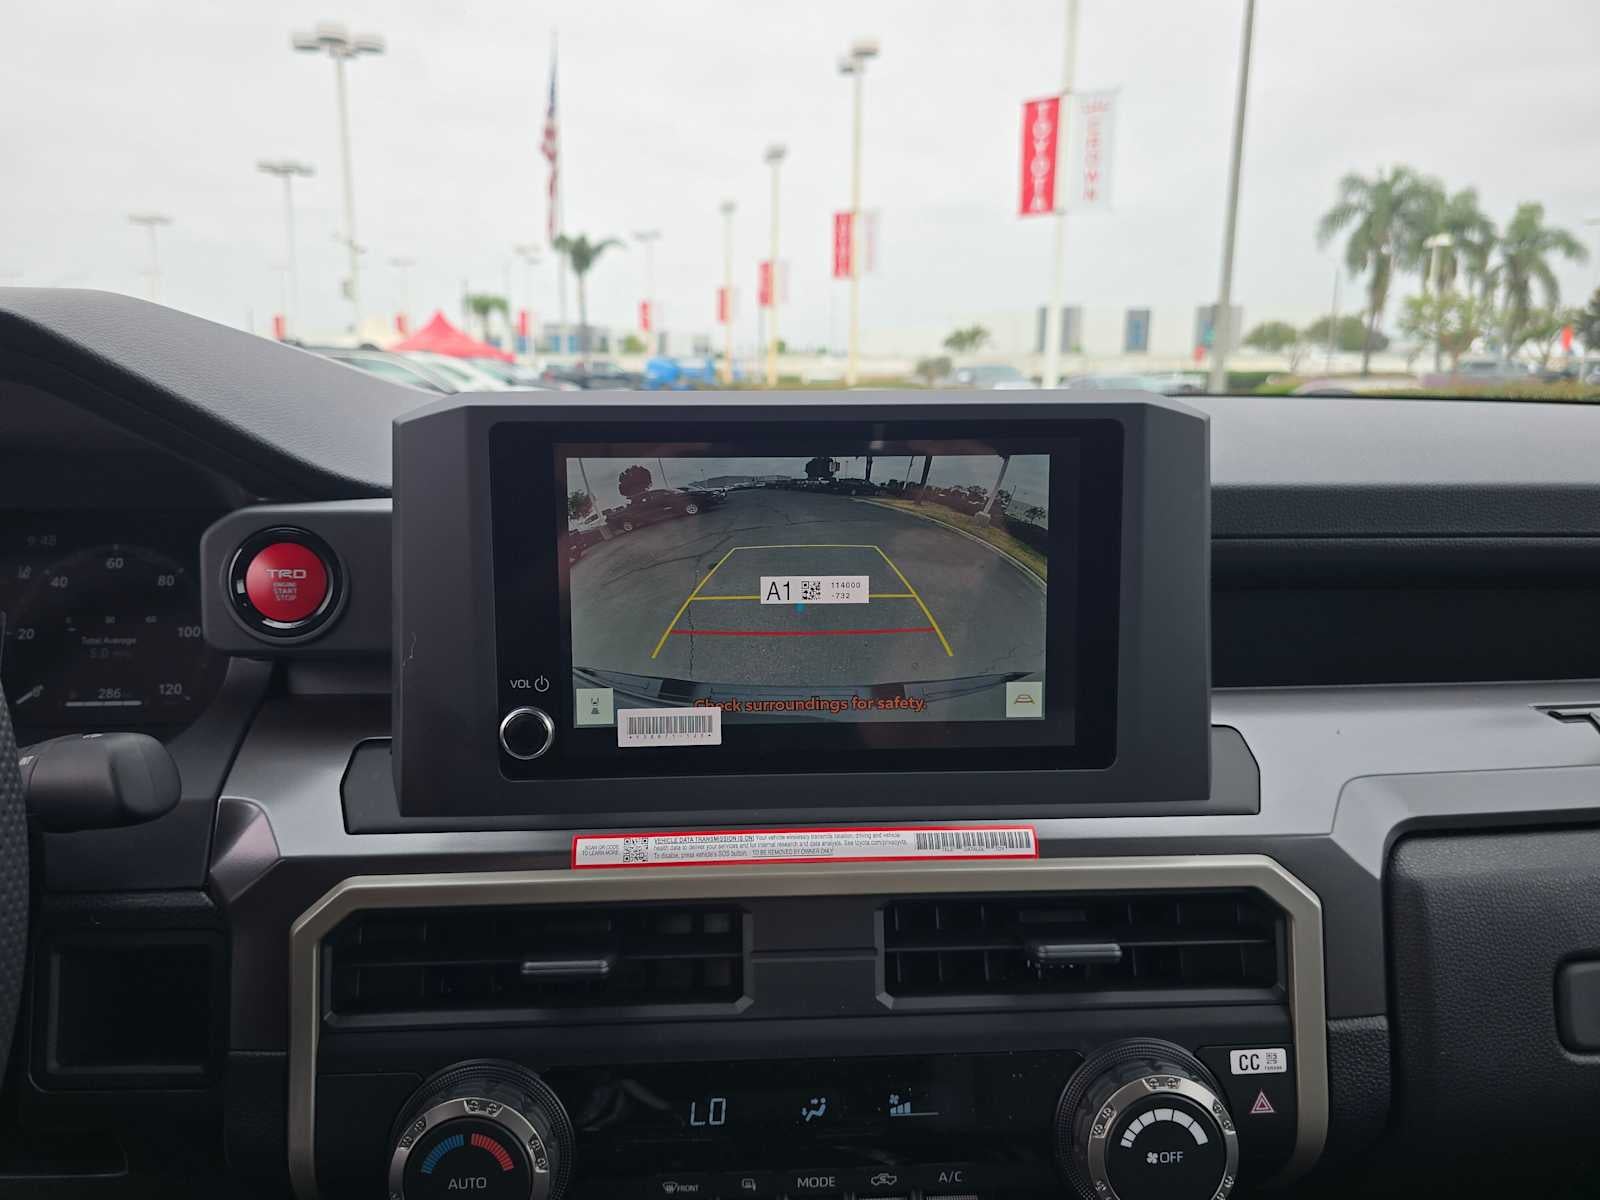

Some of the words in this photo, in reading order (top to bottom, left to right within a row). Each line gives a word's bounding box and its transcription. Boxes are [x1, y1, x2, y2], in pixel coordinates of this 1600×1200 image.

[105, 557, 124, 569] 60
[265, 568, 307, 579] TRD
[50, 575, 68, 588] 40
[157, 575, 175, 586] 80
[766, 580, 791, 601] A1
[17, 628, 35, 640] 20
[177, 626, 201, 638] 100
[159, 682, 183, 695] 120
[509, 679, 532, 689] VOL
[97, 688, 121, 699] 286
[744, 696, 848, 713] surroundings
[851, 696, 875, 709] for
[877, 696, 927, 713] safety.
[1239, 1053, 1260, 1071] CC
[690, 1097, 727, 1126] LO
[1159, 1151, 1184, 1163] OFF
[447, 1176, 488, 1190] AUTO
[797, 1177, 836, 1189] MODE
[938, 1171, 964, 1184] A/C
[676, 1184, 700, 1192] FRONT
